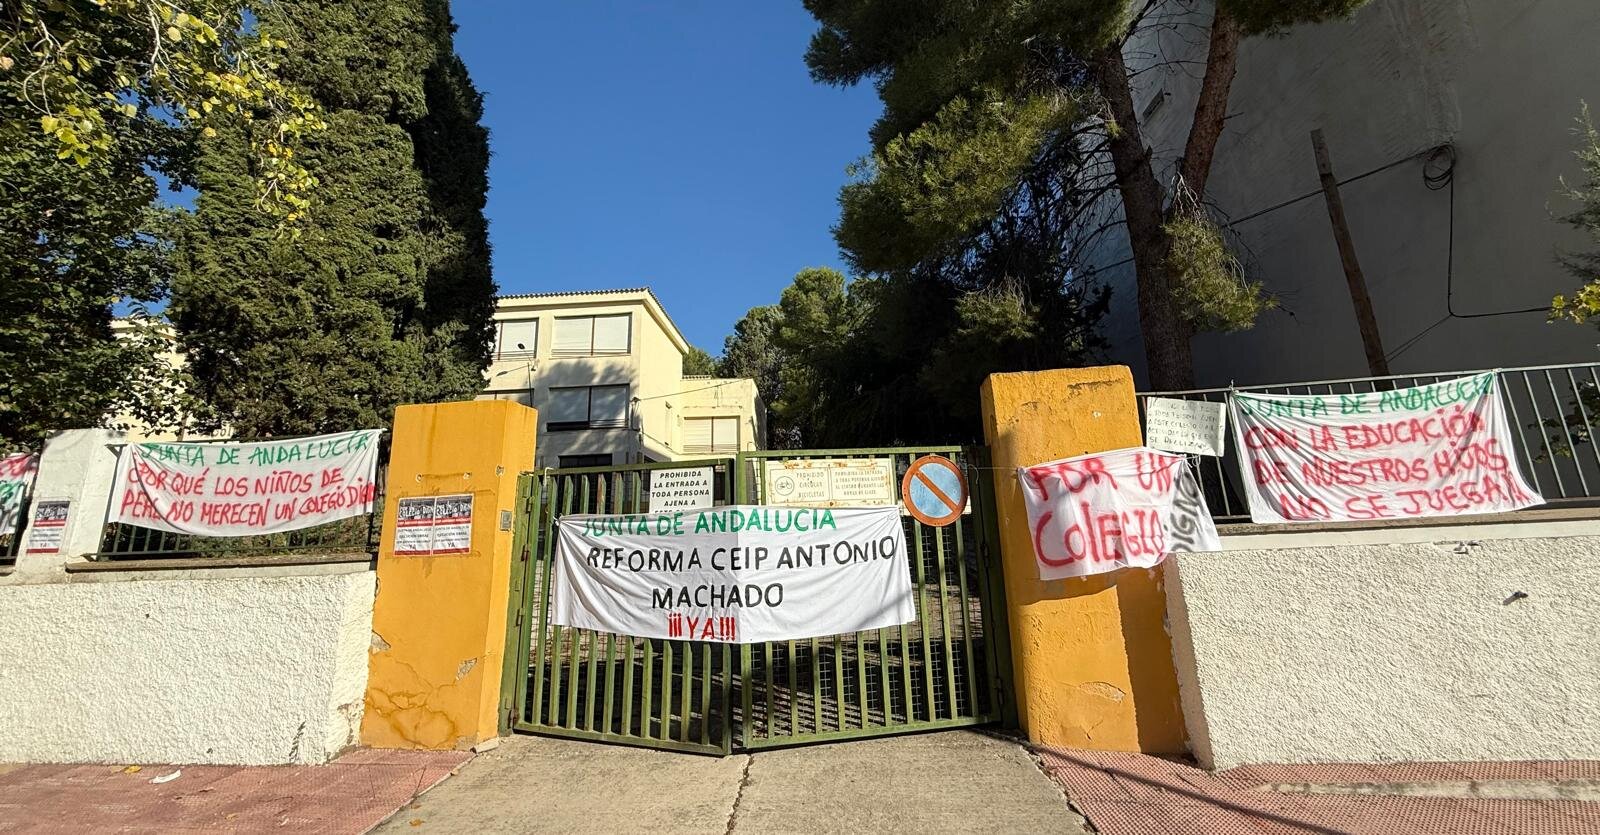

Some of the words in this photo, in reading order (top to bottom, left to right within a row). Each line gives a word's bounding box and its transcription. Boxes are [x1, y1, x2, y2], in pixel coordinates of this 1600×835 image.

[1340, 395, 1371, 414] DE
[1310, 425, 1338, 452] LA
[140, 443, 204, 466] JUNTA
[216, 448, 241, 464] DE
[171, 467, 210, 496] QUÉ
[214, 476, 249, 497] LOS
[320, 467, 344, 488] DE
[660, 471, 702, 479] PROHIBIDA
[665, 480, 700, 488] ENTRADA
[1030, 456, 1118, 501] POR
[1135, 453, 1174, 492] UN
[1255, 459, 1289, 485] DE
[1302, 456, 1429, 486] NUESTROS
[674, 489, 710, 497] PERSONA
[1280, 493, 1330, 519] NO
[1345, 494, 1392, 519] SE
[165, 501, 194, 522] NO
[200, 498, 271, 526] MERECEN
[275, 497, 298, 520] UN
[582, 515, 650, 536] JUNTA
[656, 512, 685, 535] DE
[695, 509, 837, 533] ANDALUCIA
[587, 547, 702, 572] REFORMA
[711, 547, 768, 571] CEIP
[777, 536, 895, 569] ANTONIO
[652, 583, 784, 609] MACHADO
